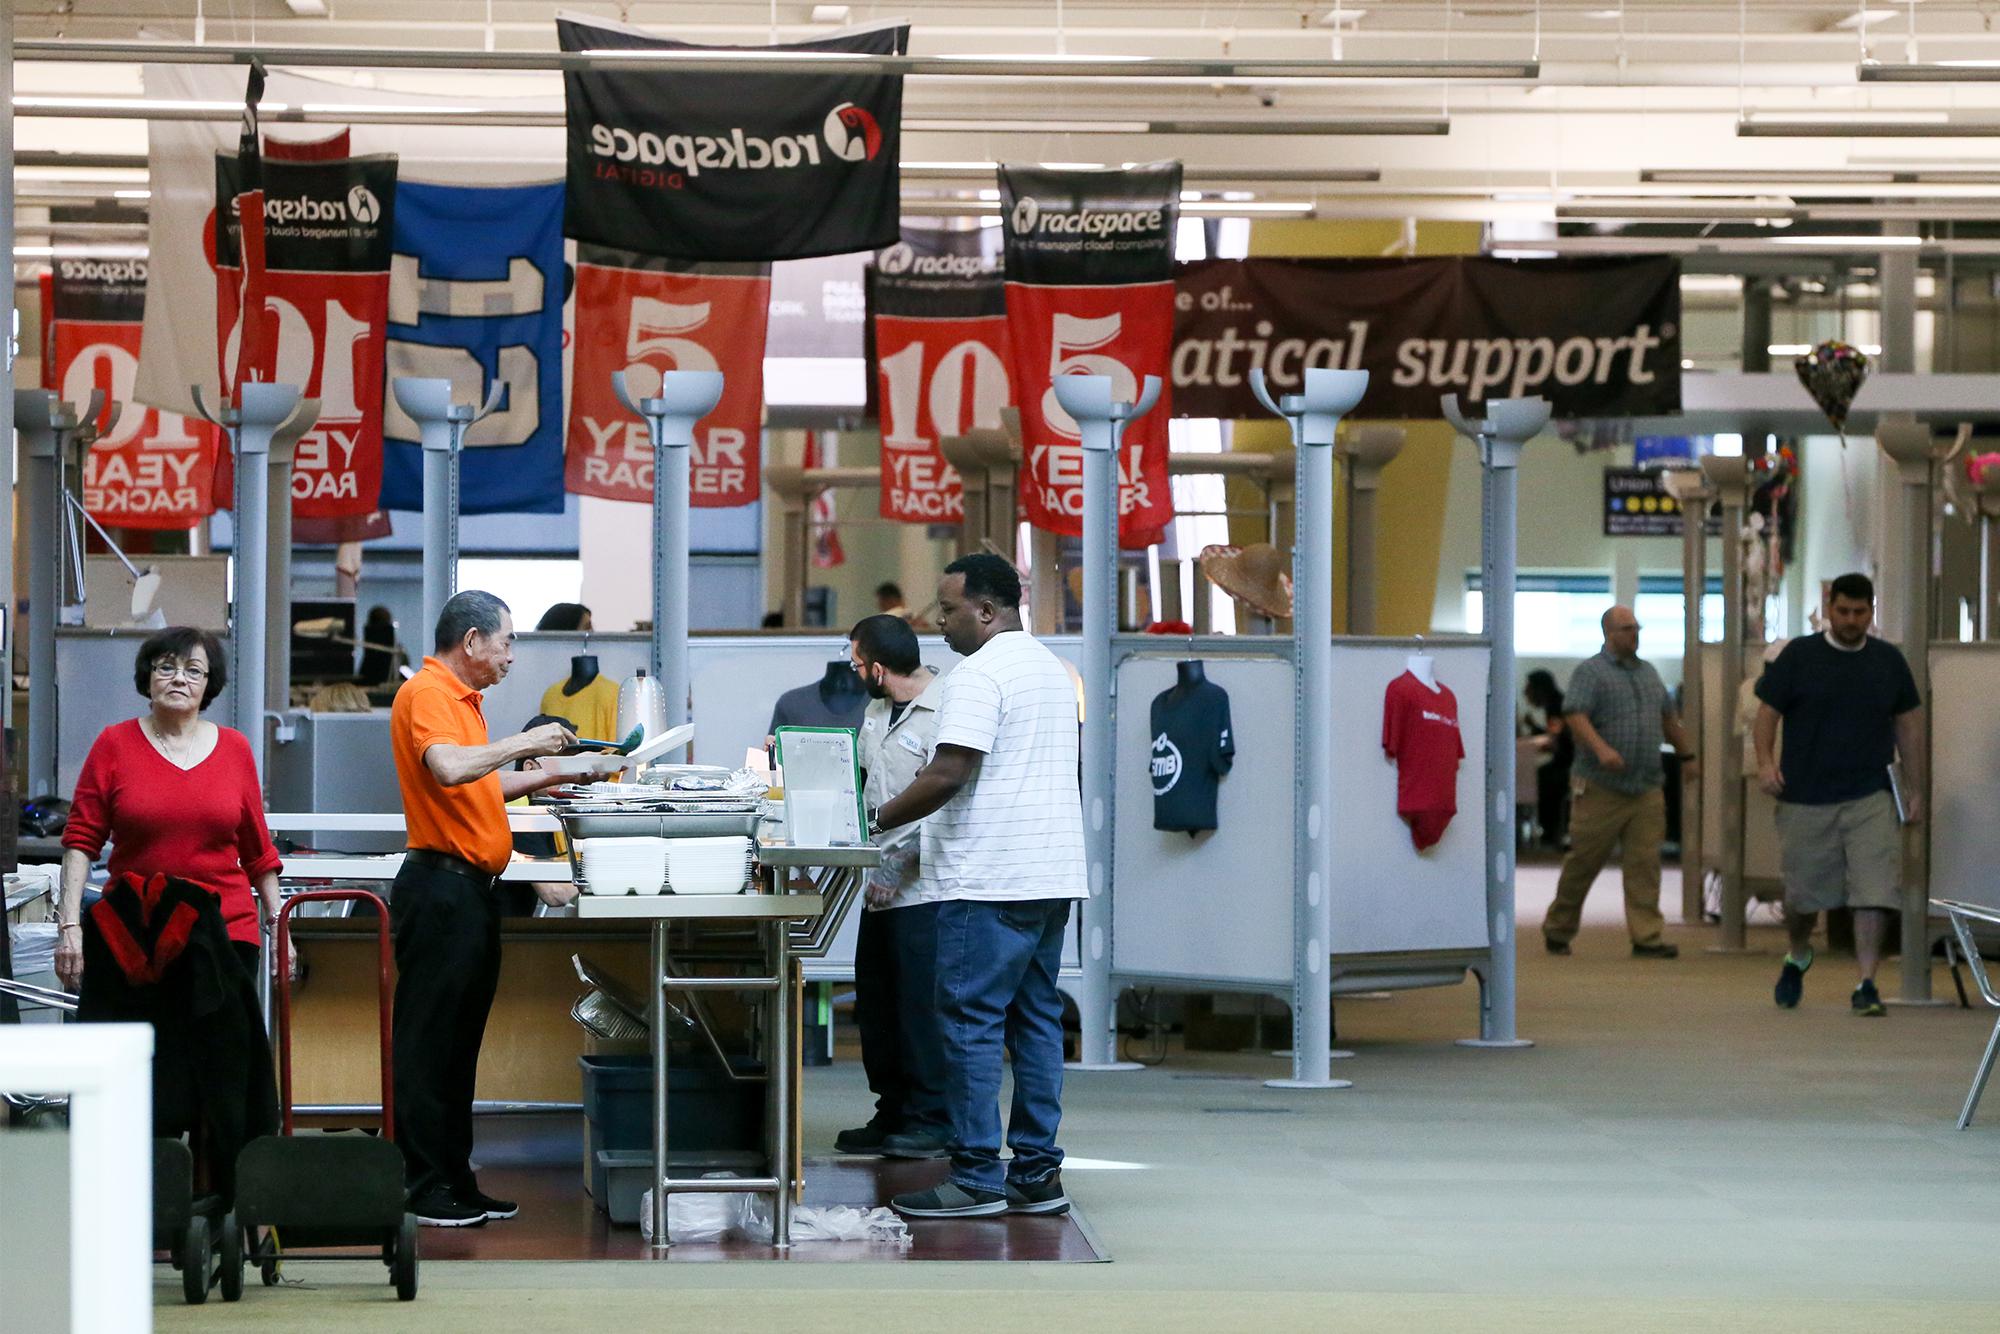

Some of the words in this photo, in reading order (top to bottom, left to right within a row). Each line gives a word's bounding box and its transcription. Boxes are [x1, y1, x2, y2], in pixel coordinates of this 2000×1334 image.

[1039, 208, 1162, 238] rackspace
[1084, 239, 1114, 250] cloud
[621, 296, 720, 410] 5
[1171, 320, 1369, 387] atical
[1392, 324, 1660, 402] support
[880, 340, 1010, 450] 10
[584, 457, 745, 494] RACER
